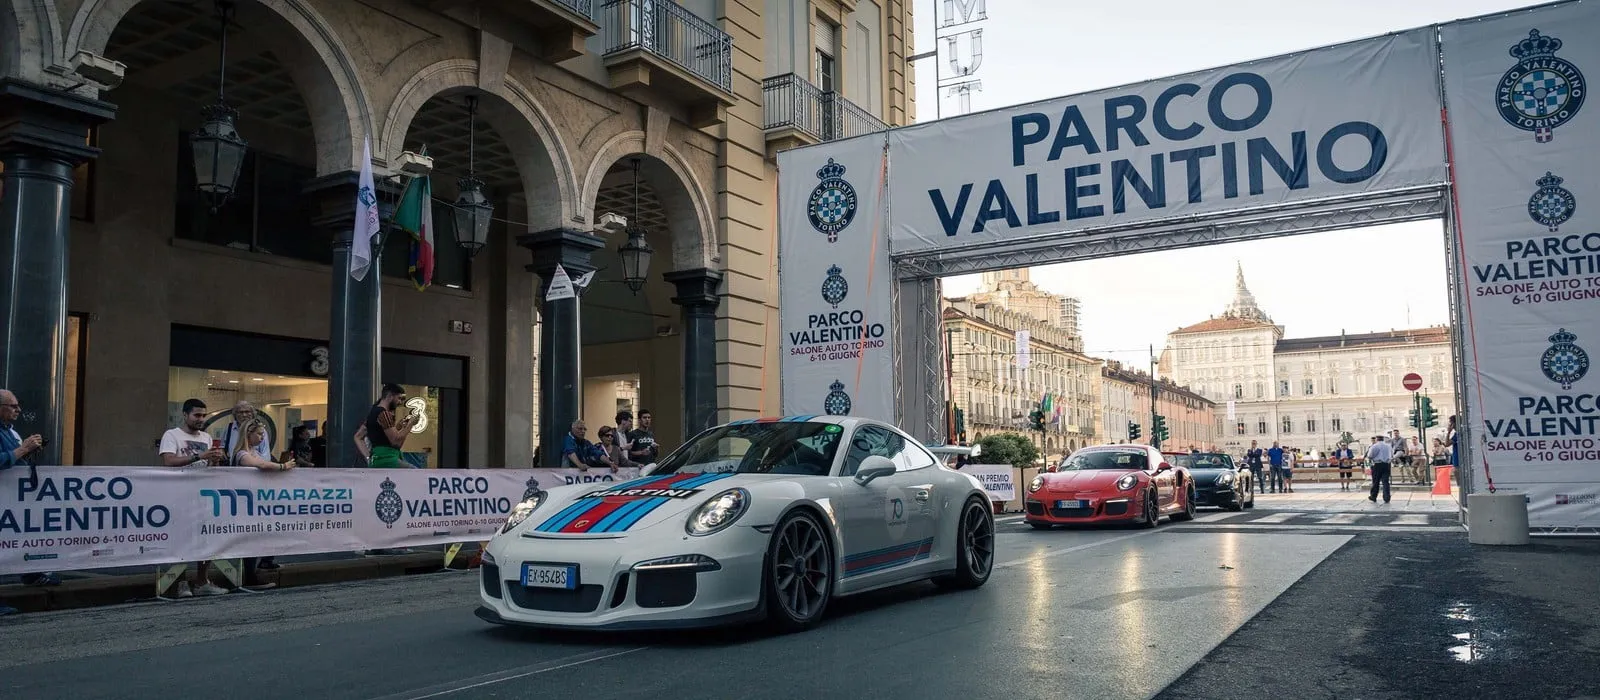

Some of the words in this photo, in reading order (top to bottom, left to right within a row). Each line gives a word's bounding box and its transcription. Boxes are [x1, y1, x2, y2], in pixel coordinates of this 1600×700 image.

[1501, 71, 1520, 108] PARCO
[1523, 60, 1581, 98] VALENTINO
[1012, 72, 1273, 167] PARCO
[1517, 110, 1569, 128] TORINO
[928, 121, 1388, 237] VALENTINO
[809, 188, 822, 217] PARCO
[823, 182, 855, 210] VALENTINO
[817, 218, 848, 232] TORINO
[1473, 254, 1600, 283] VALENTI
[1476, 283, 1535, 297] SALONE
[1539, 278, 1581, 291] AUTO
[1512, 293, 1542, 305] 6-10
[808, 309, 864, 329] PARCO
[789, 323, 885, 346] VALENTINO
[791, 345, 824, 356] SALONE
[825, 343, 849, 353] AUTO
[851, 339, 885, 350] TORINO
[311, 346, 329, 375] 3
[810, 353, 827, 362] 6-10
[1519, 394, 1600, 415] PARC
[405, 396, 428, 433] 3
[1488, 440, 1546, 451] SALONE
[1551, 438, 1594, 450] AUTO
[1524, 451, 1554, 461] 6-10
[1558, 450, 1600, 461] GIUG
[428, 476, 489, 494] PARCO
[986, 474, 1010, 482] PREMIO
[18, 476, 133, 502] PARCO
[257, 488, 353, 501] MARAZZI
[589, 489, 692, 498] MARTINI
[257, 503, 353, 516] NOLEGGIO
[406, 497, 511, 517] VALENTINO
[201, 523, 264, 535] Allestimenti
[267, 524, 272, 532] e
[275, 520, 307, 532] Servizi
[309, 521, 324, 532] per
[326, 519, 353, 530] Eventi
[406, 521, 432, 529] SALONE
[433, 520, 450, 528] AUTO
[451, 519, 474, 527] TORINO
[474, 518, 487, 526] 6-10
[22, 538, 55, 549] AUTO
[57, 536, 100, 547] TORINO
[103, 535, 125, 544] 6-10
[127, 533, 169, 543] GIUGNO
